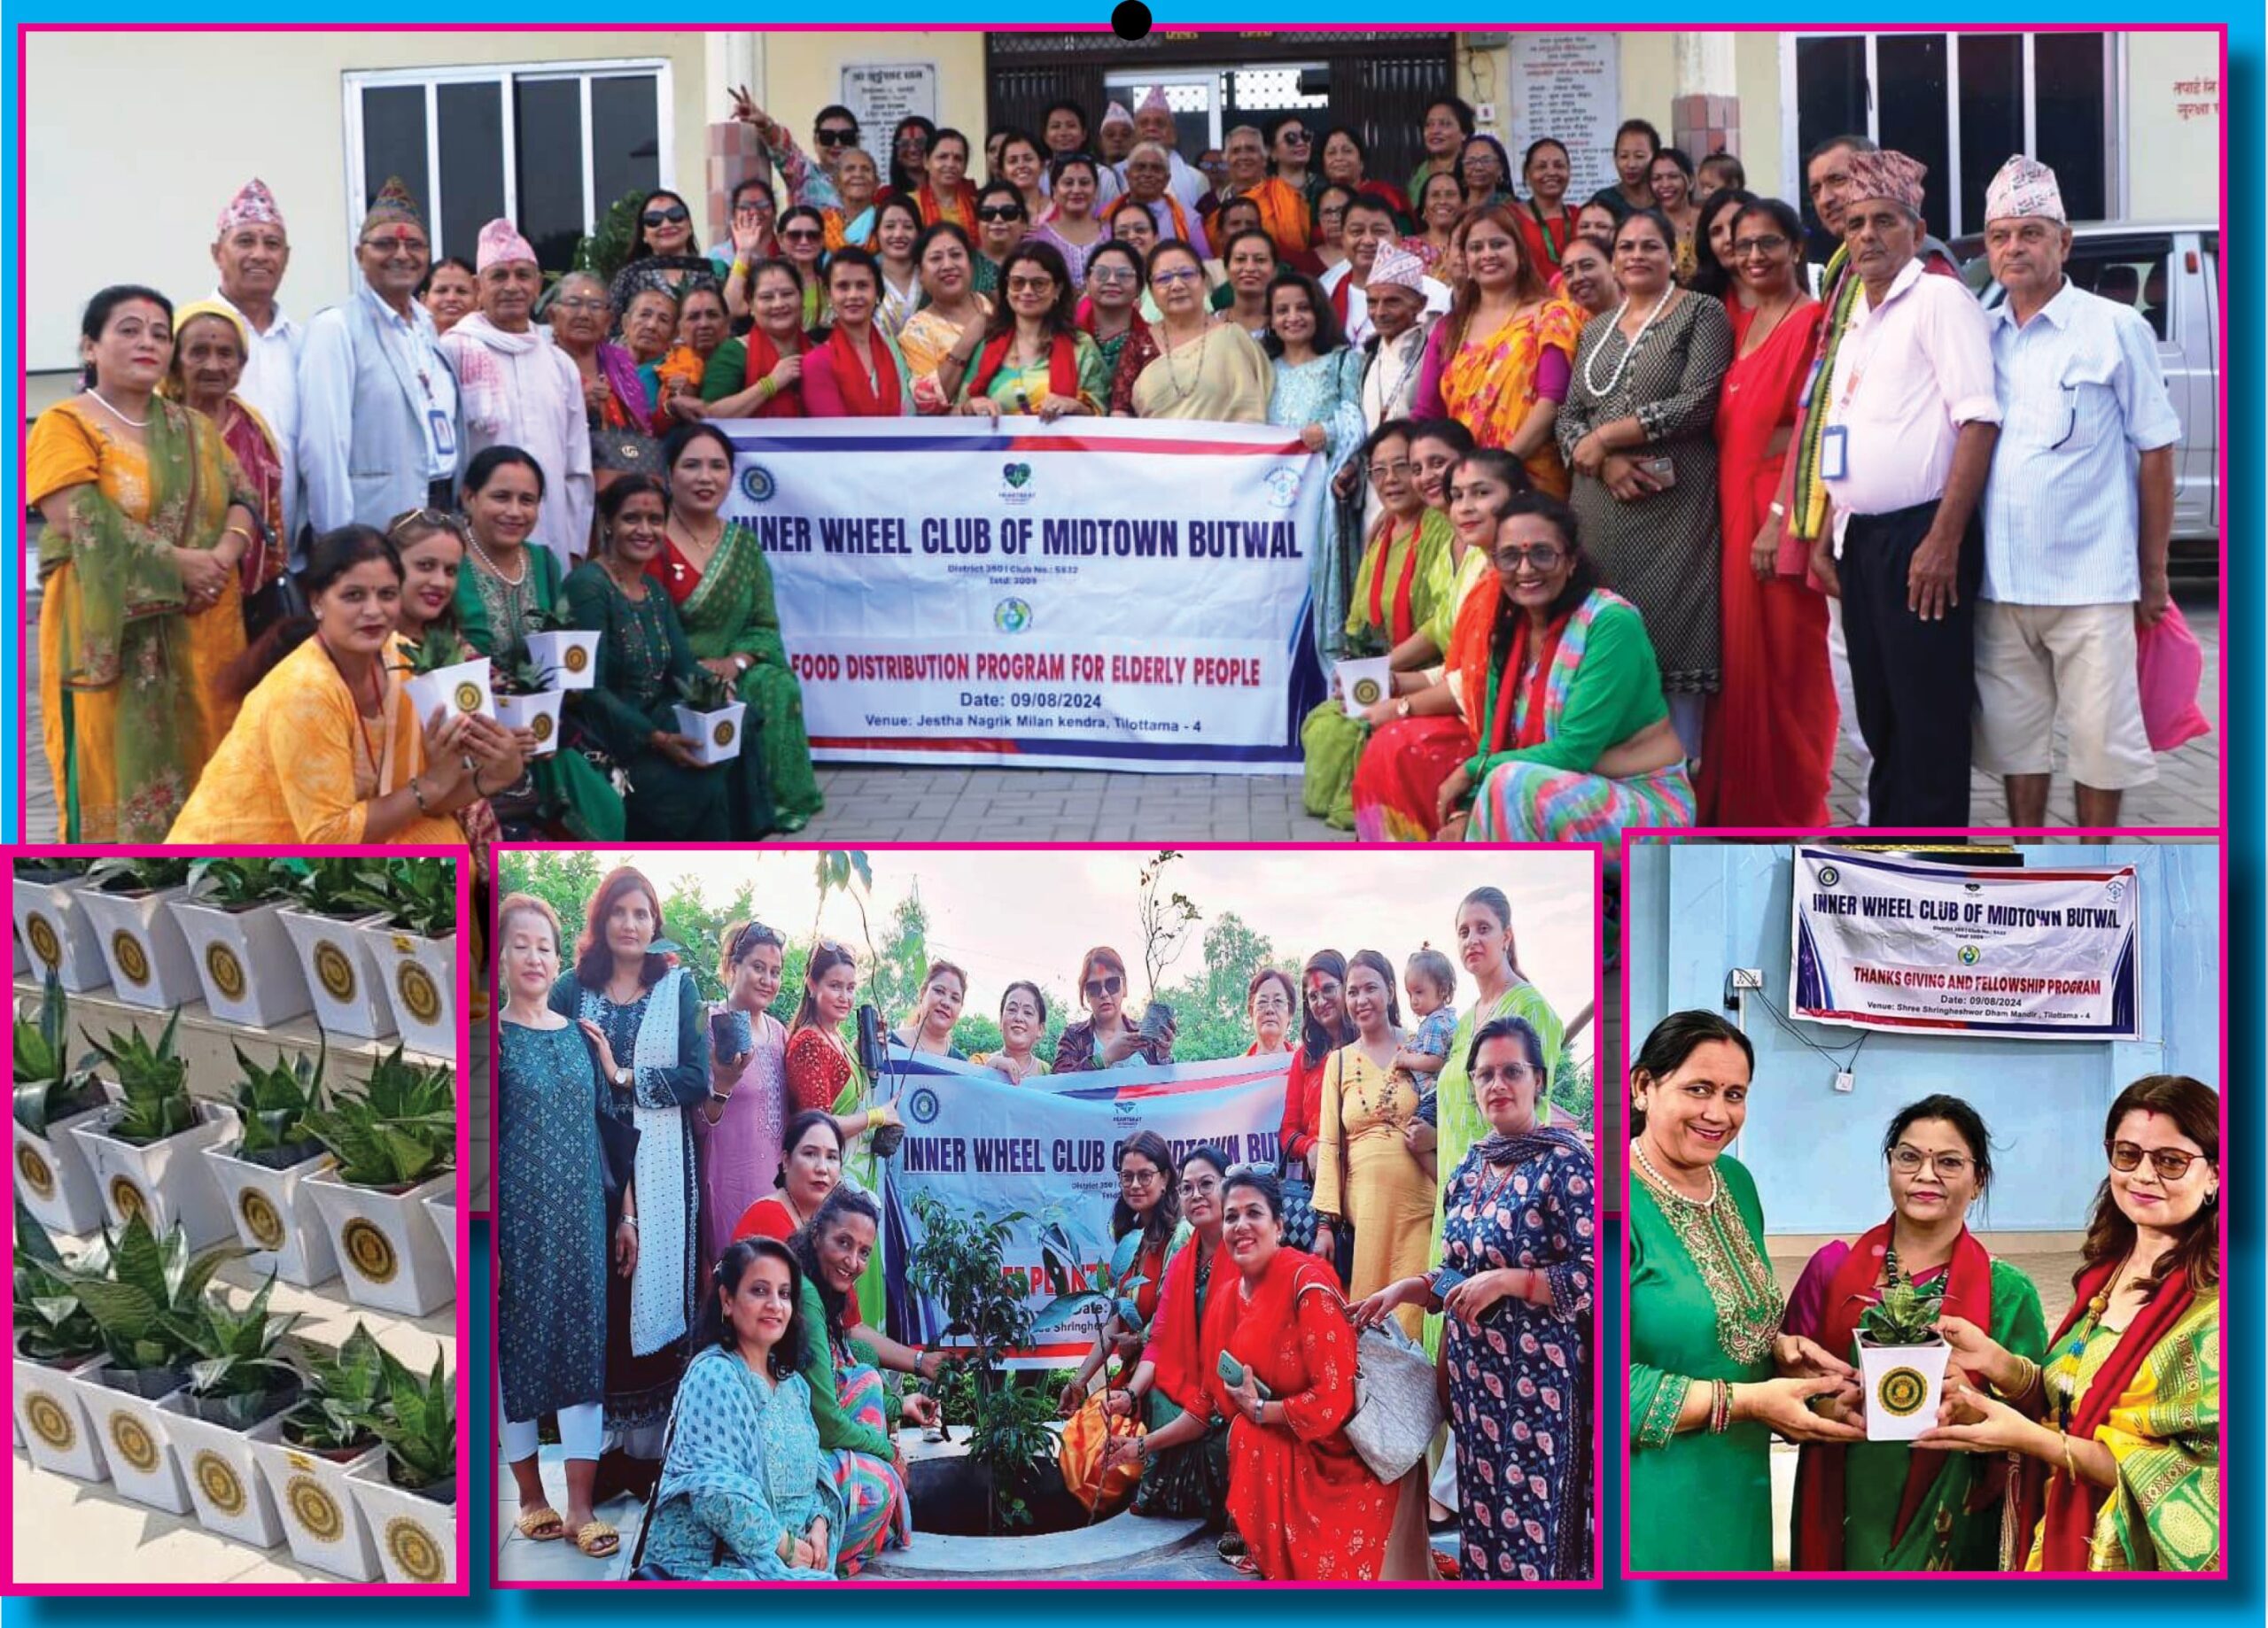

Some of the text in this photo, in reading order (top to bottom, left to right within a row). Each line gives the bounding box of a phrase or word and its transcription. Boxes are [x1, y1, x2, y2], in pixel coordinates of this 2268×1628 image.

[732, 516, 1303, 558] NER WHEEL CLUB OF MIDTOWN BUTWAL
[792, 653, 1260, 686] FOOD DISTRIBUTION PROGRAM FOR ELDERLY PEOPLE
[960, 693, 1101, 709] Date: 09/08/2024
[866, 715, 912, 726] Venue:
[917, 715, 963, 727] Jestha
[968, 715, 1012, 730] Nagrik
[1018, 715, 1052, 728] Milan
[1115, 717, 1179, 732] Tilottama
[1192, 721, 1201, 732] 4
[1814, 894, 2121, 928] INNER WHEEL CLUB OF MIDTOWN BUTWAL
[1853, 966, 2101, 995] THANKS GIVING AND FELLOWSHIP PROGRAM
[1867, 1001, 1894, 1010] Venue:
[1897, 1004, 1920, 1012] Shree
[1941, 995, 2022, 1006] Date: 09/08/2024
[904, 1136, 967, 1172] INNER
[974, 1137, 1045, 1173] WHEEL
[1052, 1139, 1105, 1173] CLUB
[1074, 1302, 1109, 1315] ate:
